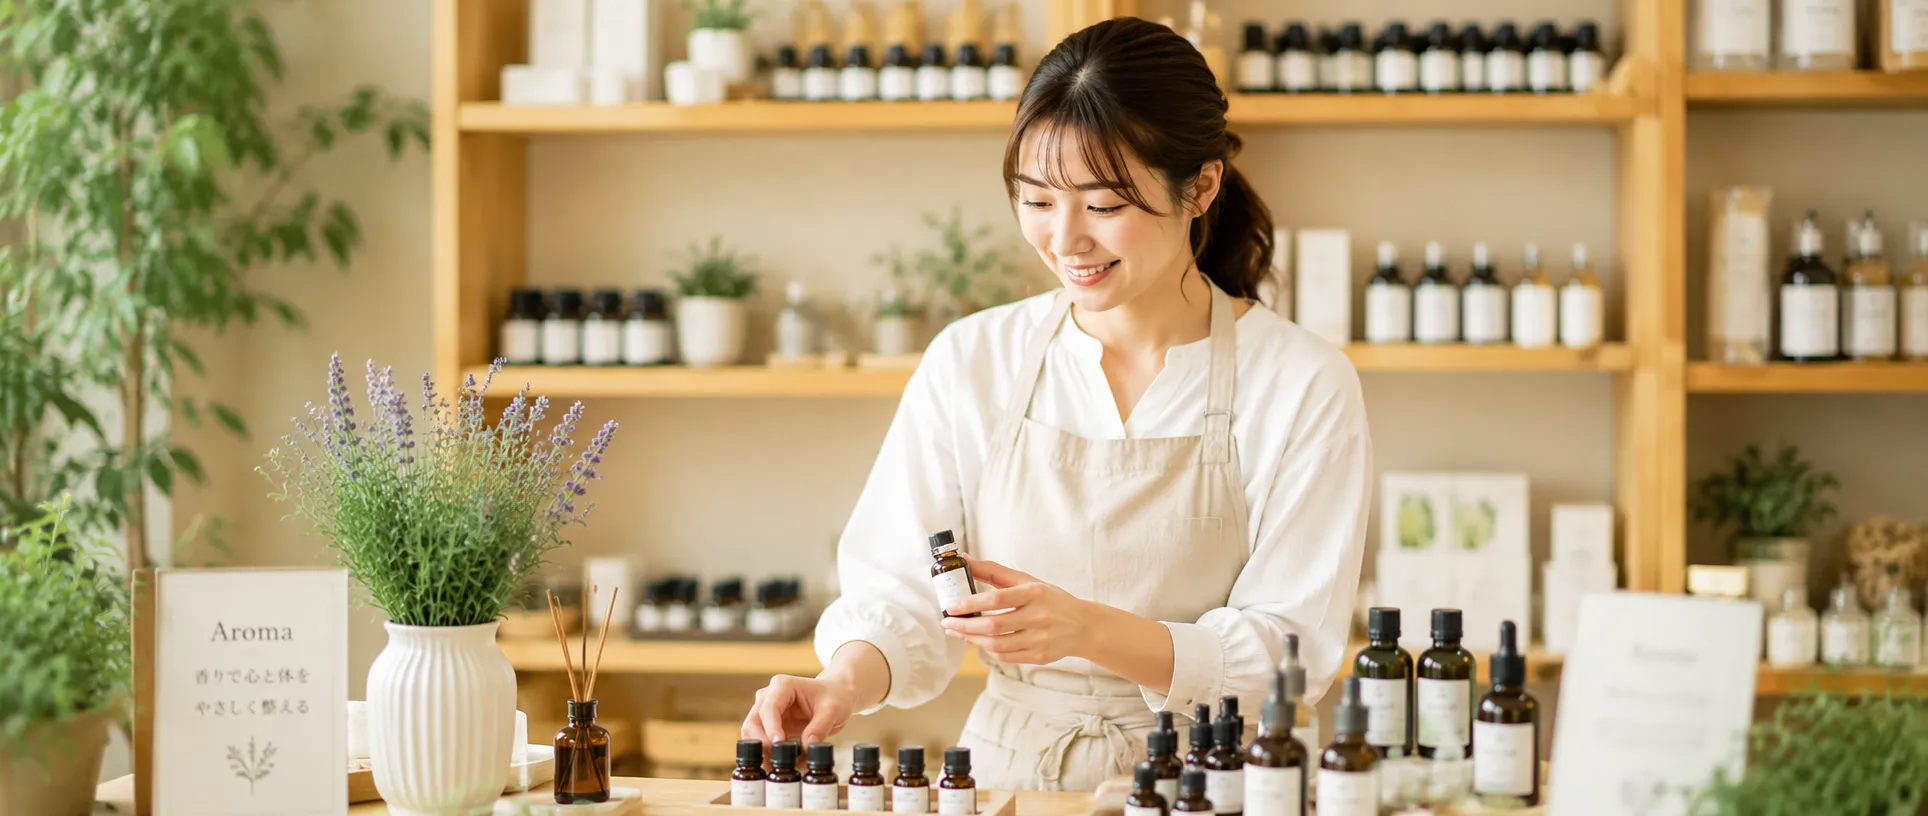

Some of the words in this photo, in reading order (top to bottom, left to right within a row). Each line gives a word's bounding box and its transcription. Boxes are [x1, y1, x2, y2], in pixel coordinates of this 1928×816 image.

[210, 621, 293, 641] Aroma
[195, 668, 311, 685] 香りで心と体を
[195, 699, 309, 715] やさしく整える
